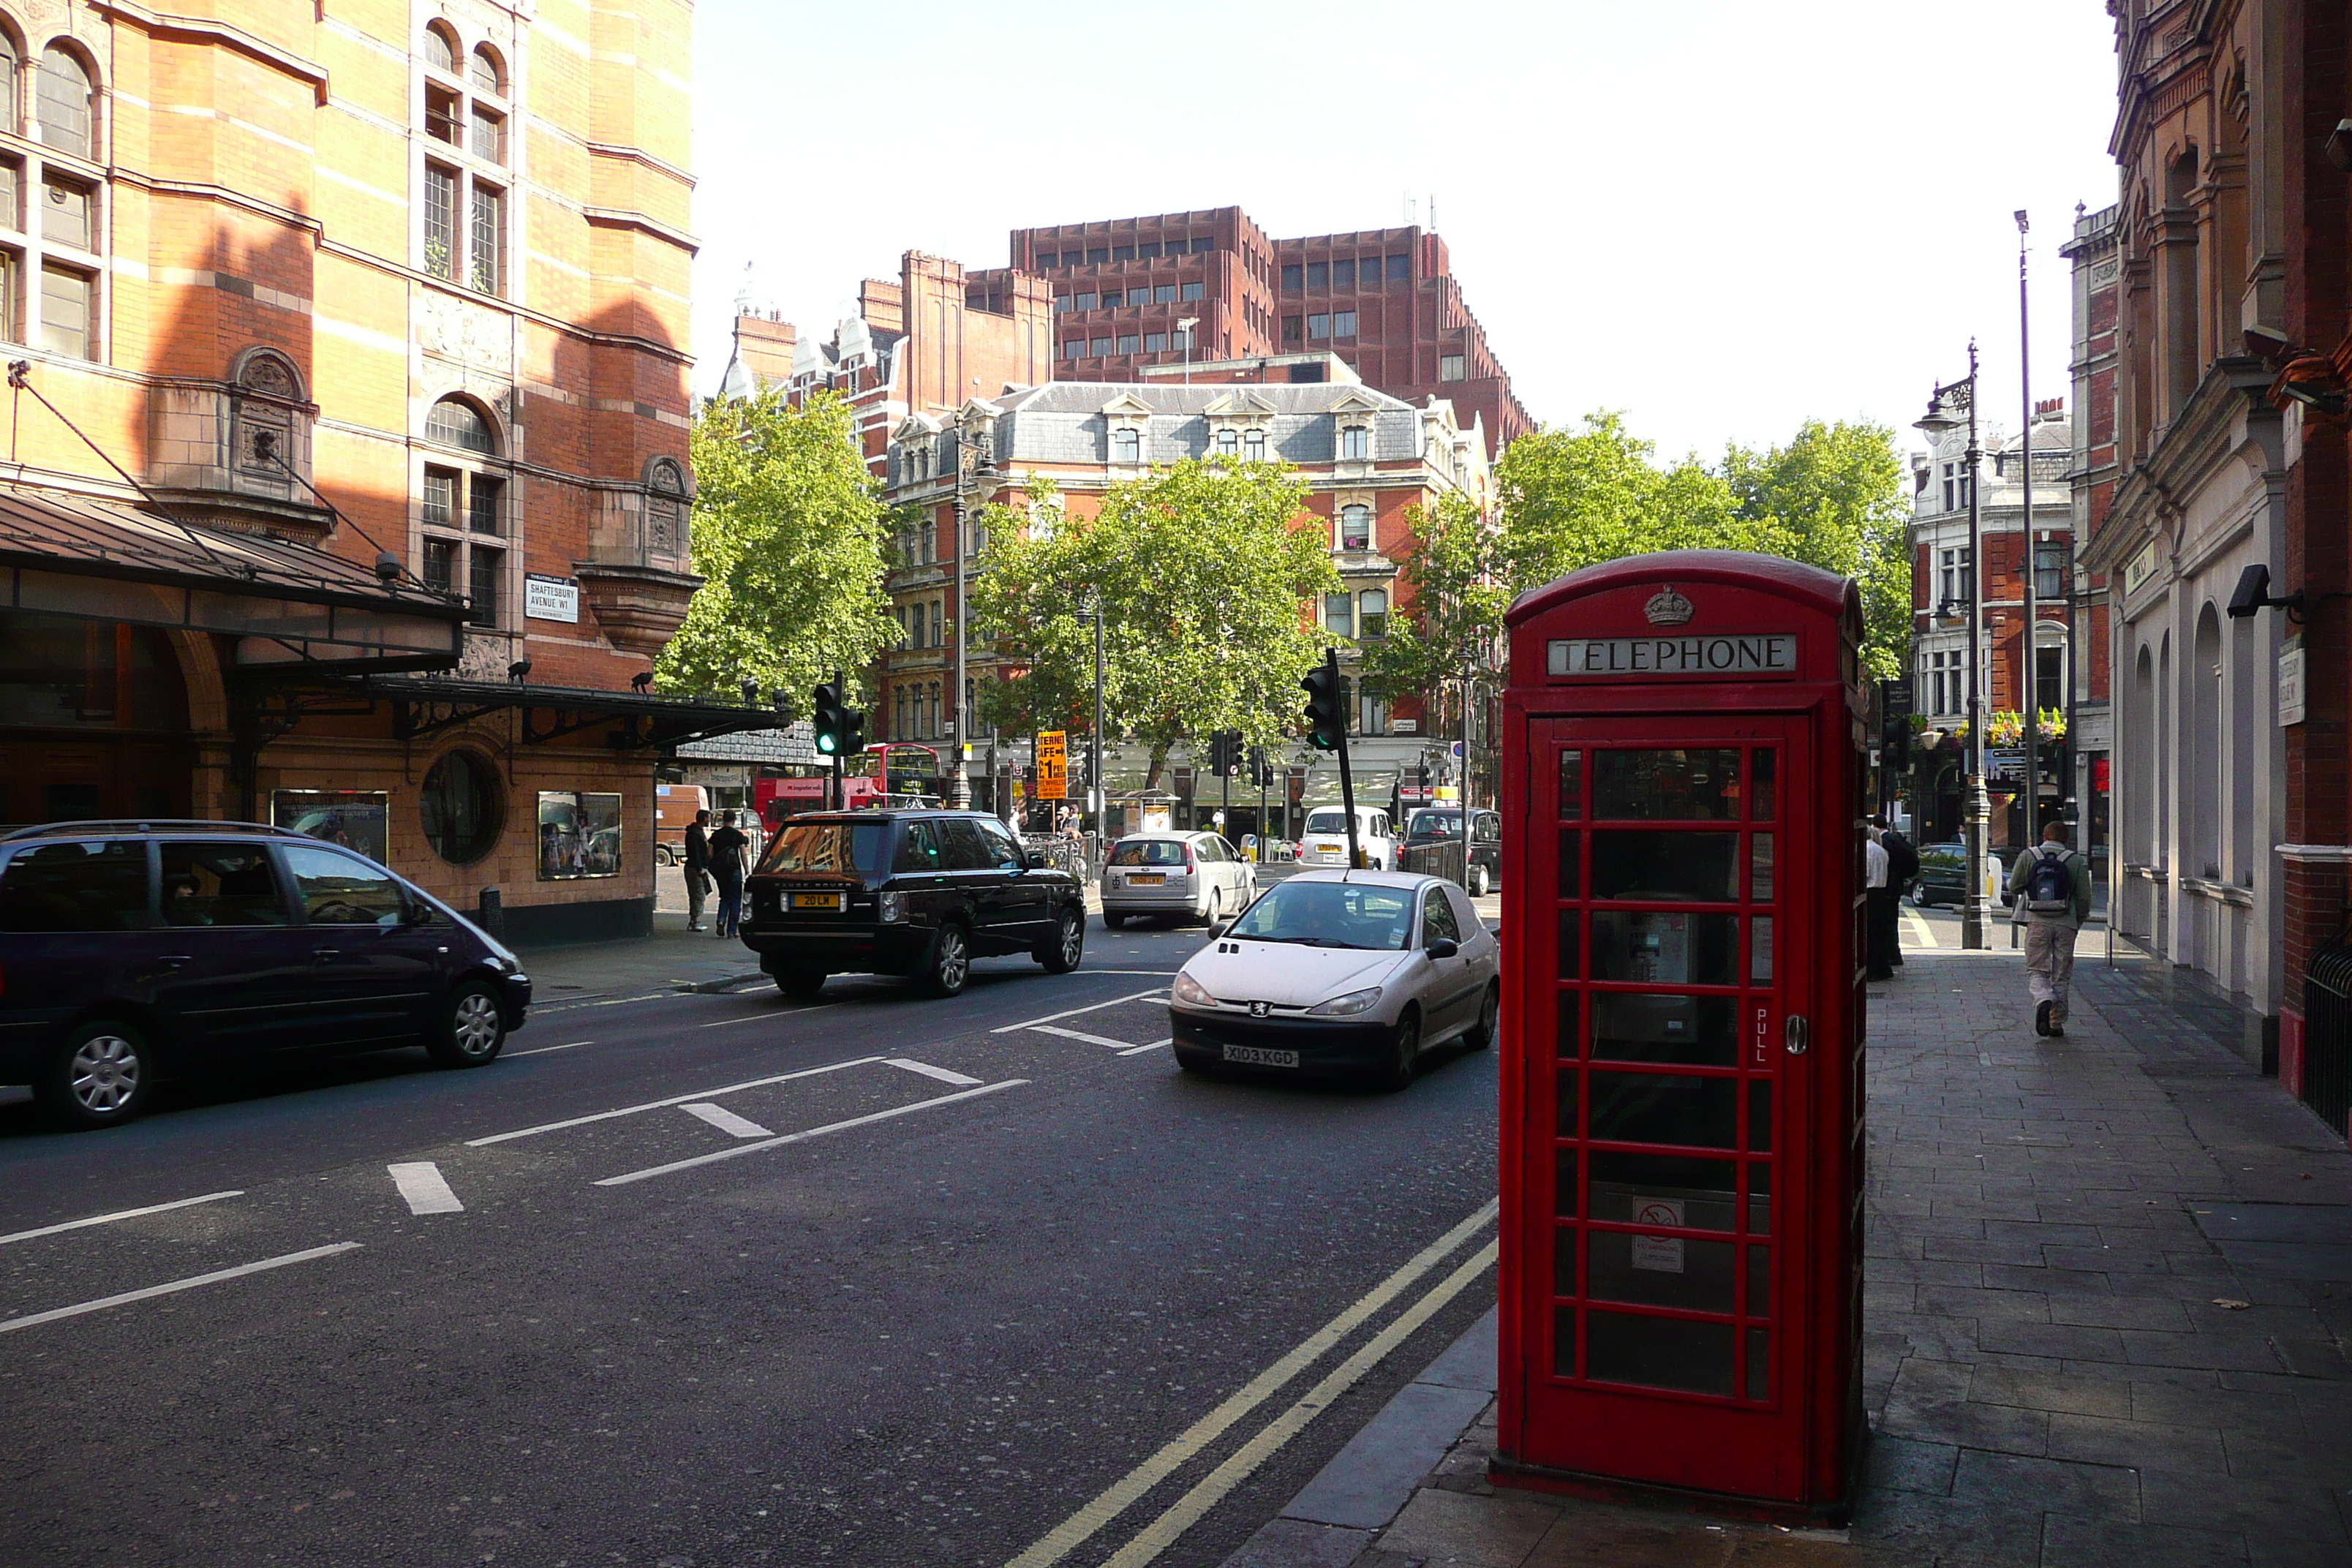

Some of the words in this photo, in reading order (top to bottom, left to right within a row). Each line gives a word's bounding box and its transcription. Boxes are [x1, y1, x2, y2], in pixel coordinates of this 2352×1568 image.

[531, 584, 574, 599] SHAFTESBURY
[530, 596, 556, 608] AVENUE
[559, 600, 568, 610] W1
[1556, 638, 1786, 671] TELEPHONE
[1039, 735, 1065, 745] TERNET
[1039, 747, 1055, 758] AFE
[1039, 759, 1052, 779] £1
[804, 896, 815, 905] 20
[1757, 1009, 1766, 1062] PULL
[1263, 1050, 1293, 1065] KGD
